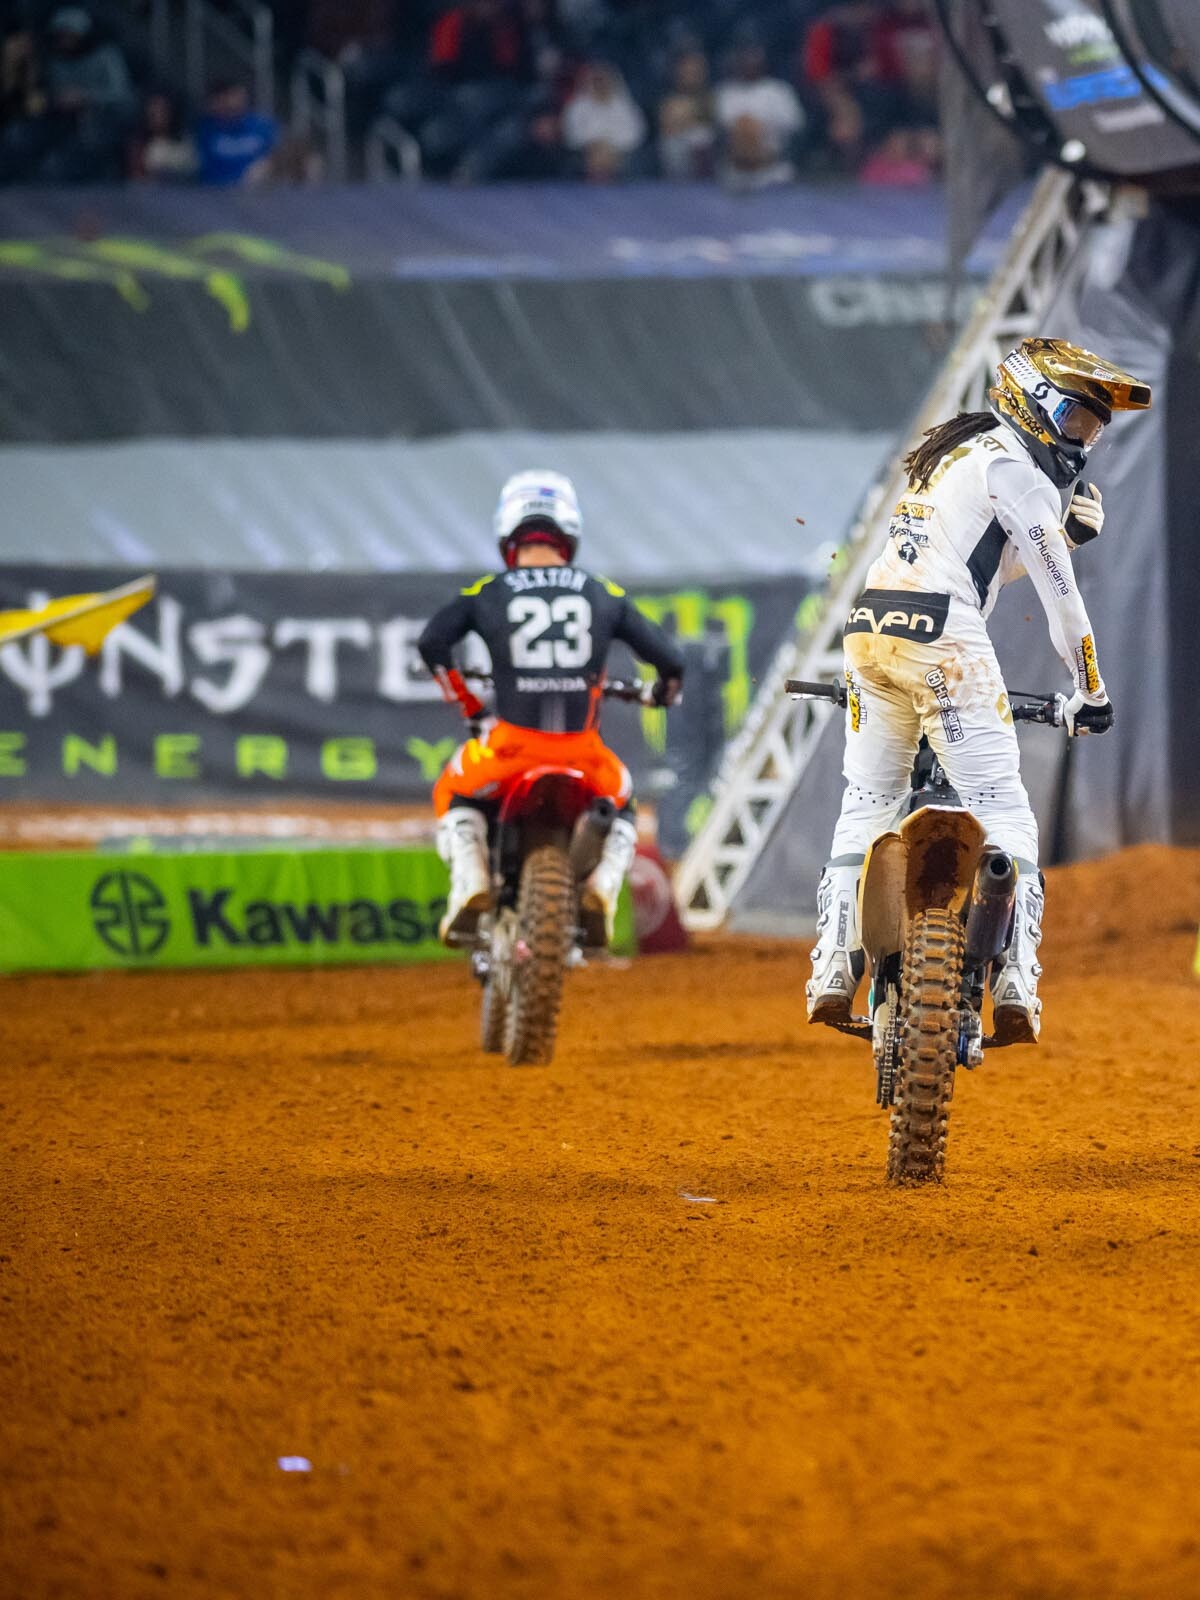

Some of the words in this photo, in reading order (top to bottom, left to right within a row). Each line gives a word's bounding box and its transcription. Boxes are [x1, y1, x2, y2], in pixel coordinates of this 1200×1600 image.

[504, 567, 589, 592] SEXTON
[1036, 539, 1069, 596] Husqvarna
[507, 595, 592, 669] 23
[516, 677, 588, 692] HONDA
[933, 685, 964, 741] Husvarna
